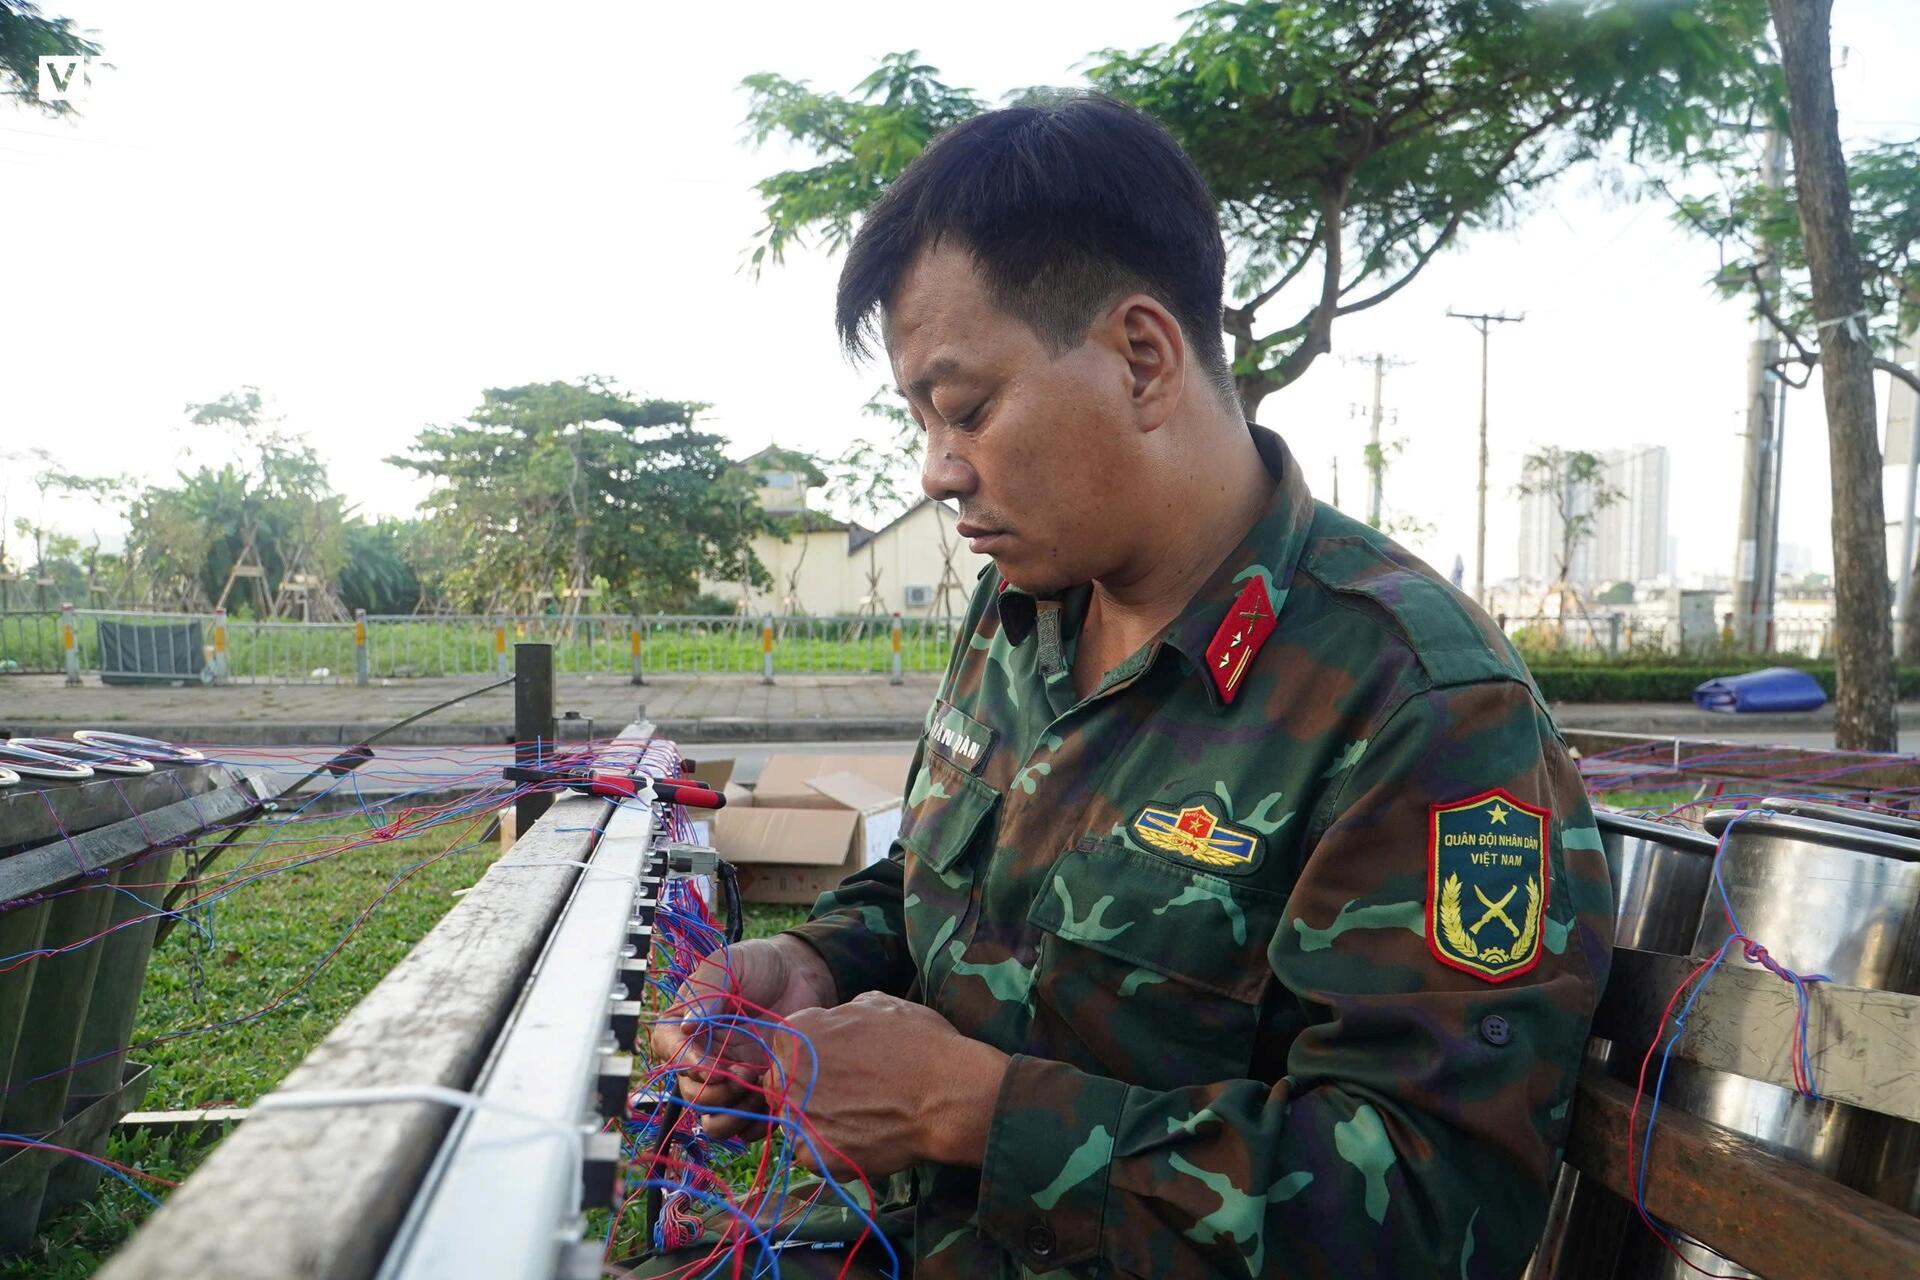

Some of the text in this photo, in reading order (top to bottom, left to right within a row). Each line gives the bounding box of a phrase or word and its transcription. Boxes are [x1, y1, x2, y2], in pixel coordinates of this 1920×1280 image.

[1444, 831, 1539, 850] QUÂN ĐỘI NHÂN DÂN
[1470, 851, 1523, 868] VIỆT NAM
